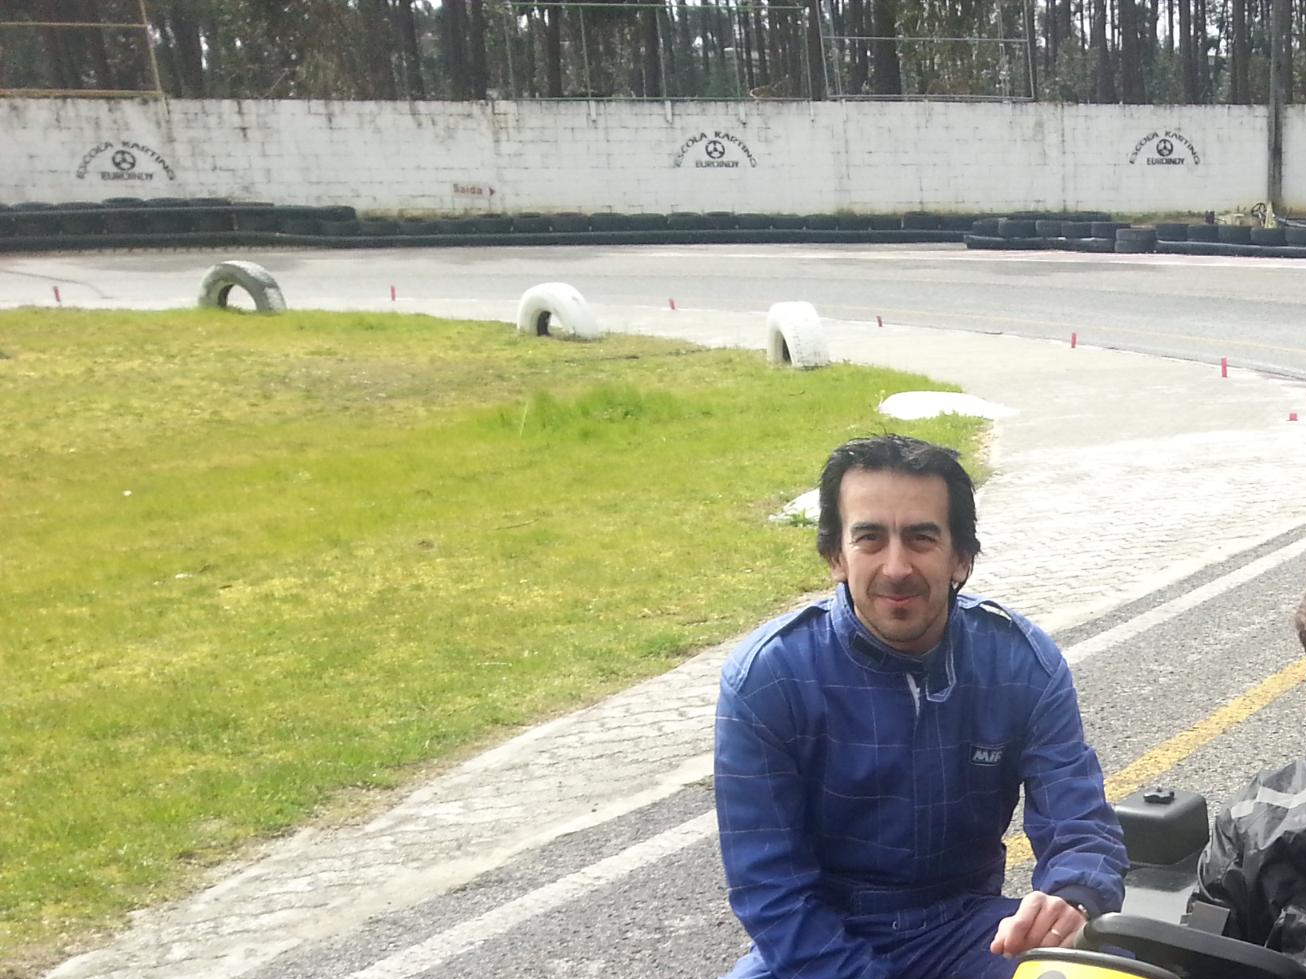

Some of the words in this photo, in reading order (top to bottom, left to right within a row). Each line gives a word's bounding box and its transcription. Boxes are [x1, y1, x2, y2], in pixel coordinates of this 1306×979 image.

[122, 141, 175, 181] KARTING
[714, 131, 757, 168] KARTING
[1165, 131, 1200, 165] KARTING
